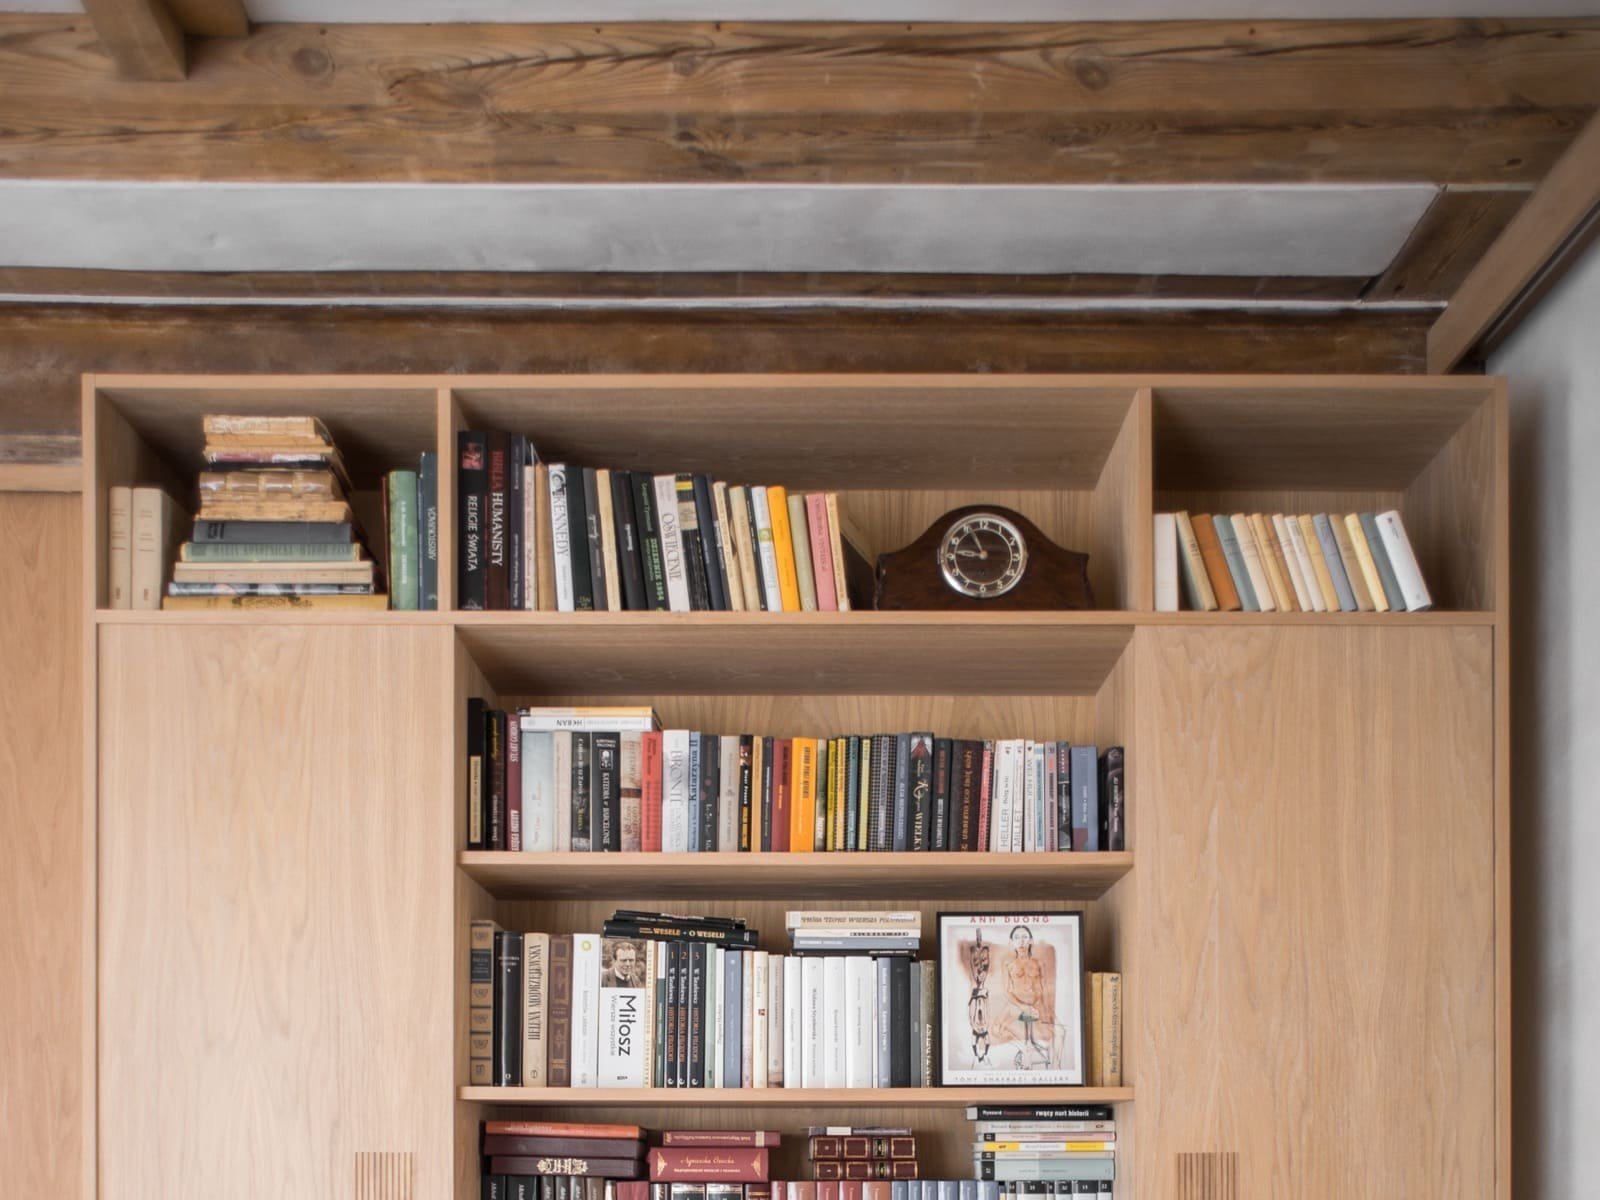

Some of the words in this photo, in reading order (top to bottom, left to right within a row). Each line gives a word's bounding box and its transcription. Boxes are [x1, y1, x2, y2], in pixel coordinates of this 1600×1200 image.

[492, 452, 503, 490] BIBLIA
[468, 496, 478, 531] RELIGIE
[492, 493, 504, 566] HUMANISTY
[468, 534, 480, 571] ŚWIATA
[528, 1011, 541, 1040] HELENA
[618, 994, 637, 1057] Miłosz
